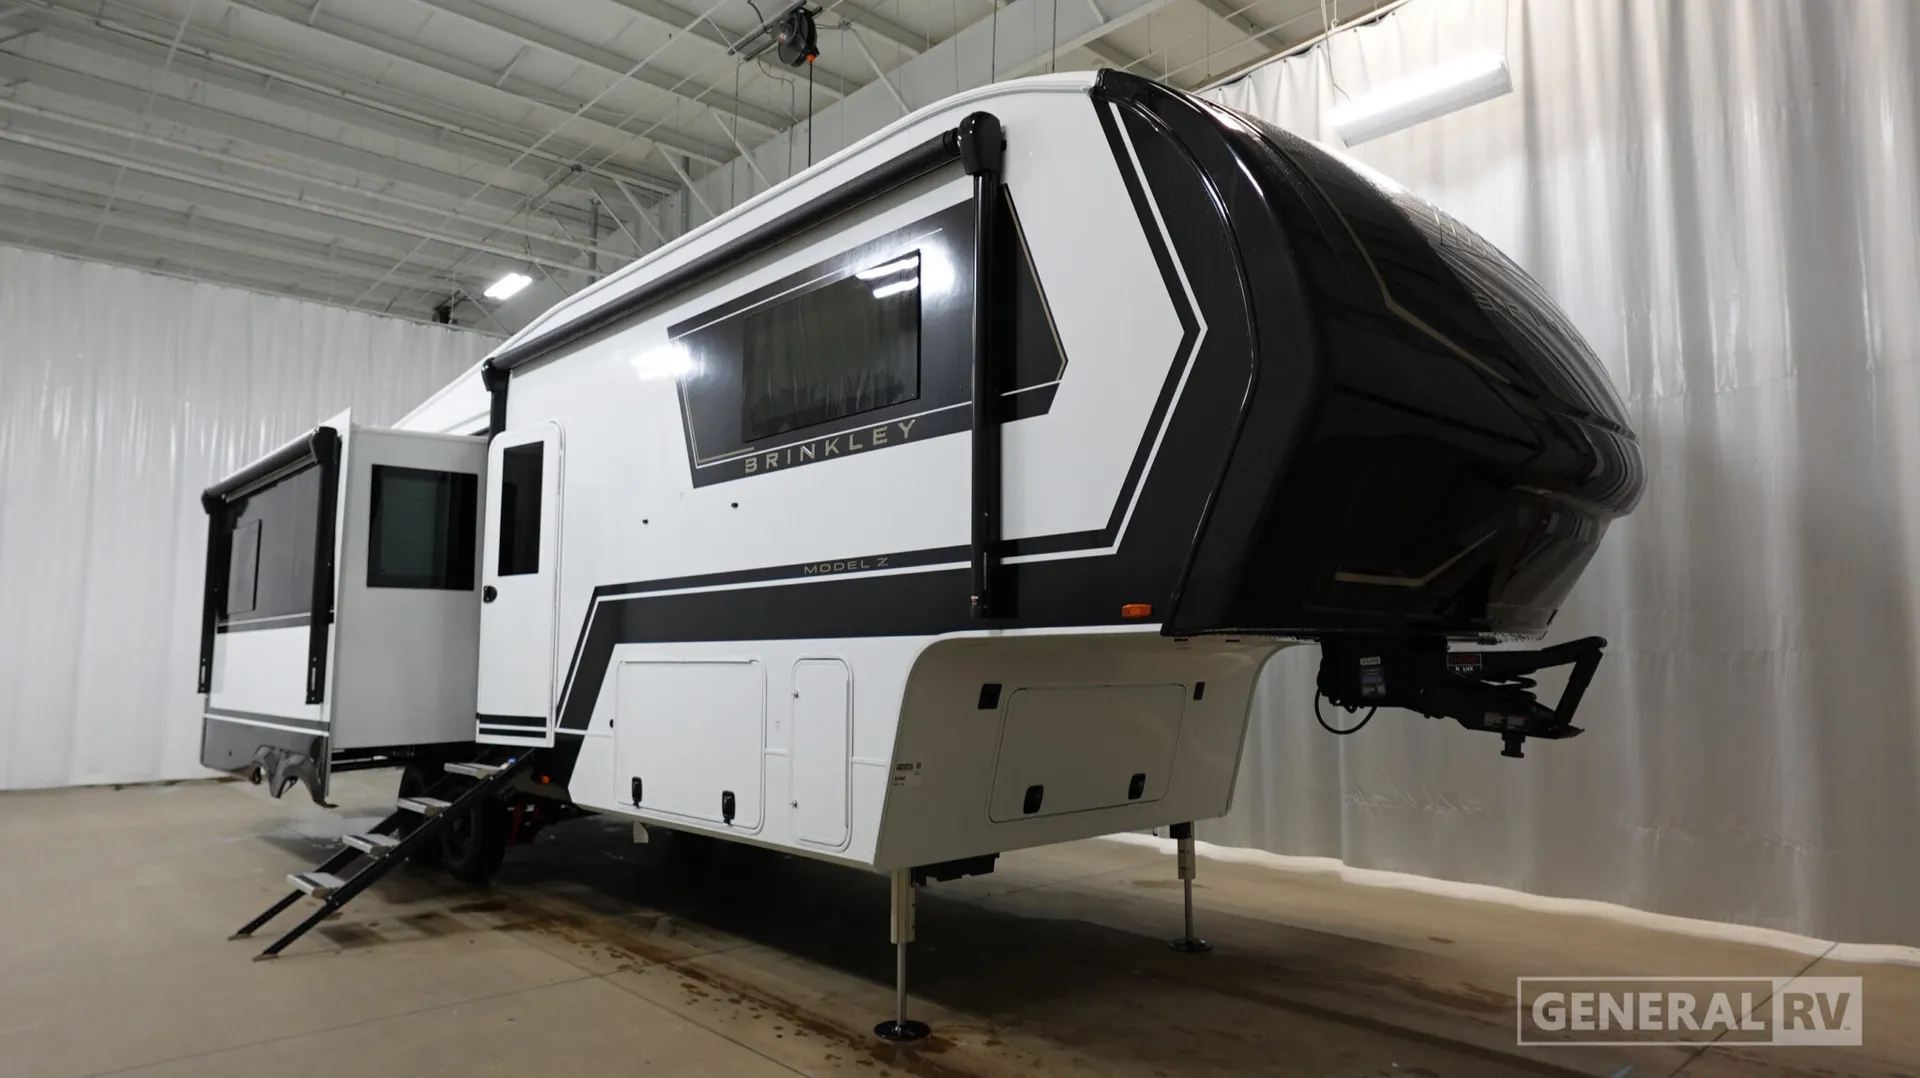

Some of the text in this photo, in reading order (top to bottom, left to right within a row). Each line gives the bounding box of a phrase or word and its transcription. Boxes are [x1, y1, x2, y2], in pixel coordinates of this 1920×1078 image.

[745, 419, 915, 473] BRINKLEY
[804, 557, 889, 574] MODEL Z
